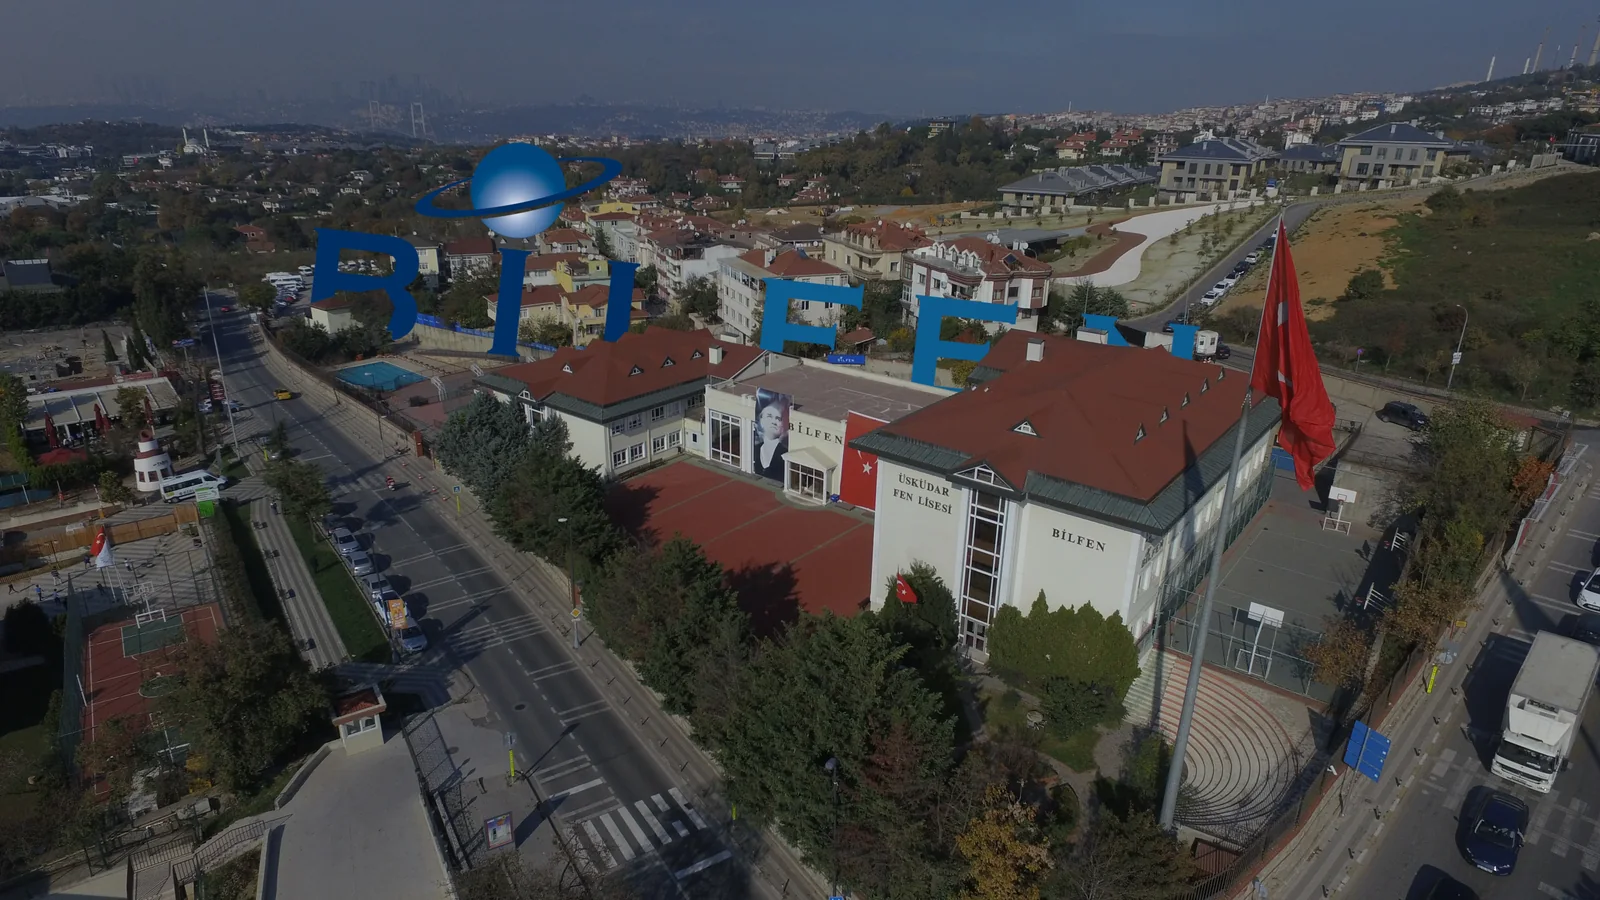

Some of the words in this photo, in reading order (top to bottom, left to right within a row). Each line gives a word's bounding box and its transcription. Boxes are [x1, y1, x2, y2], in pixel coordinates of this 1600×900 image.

[788, 422, 843, 445] BİLFEN
[898, 472, 950, 497] ÜSKÜDAR
[893, 488, 914, 502] FEN
[918, 495, 953, 515] LİSESİ
[1052, 527, 1107, 552] BİLFEN
